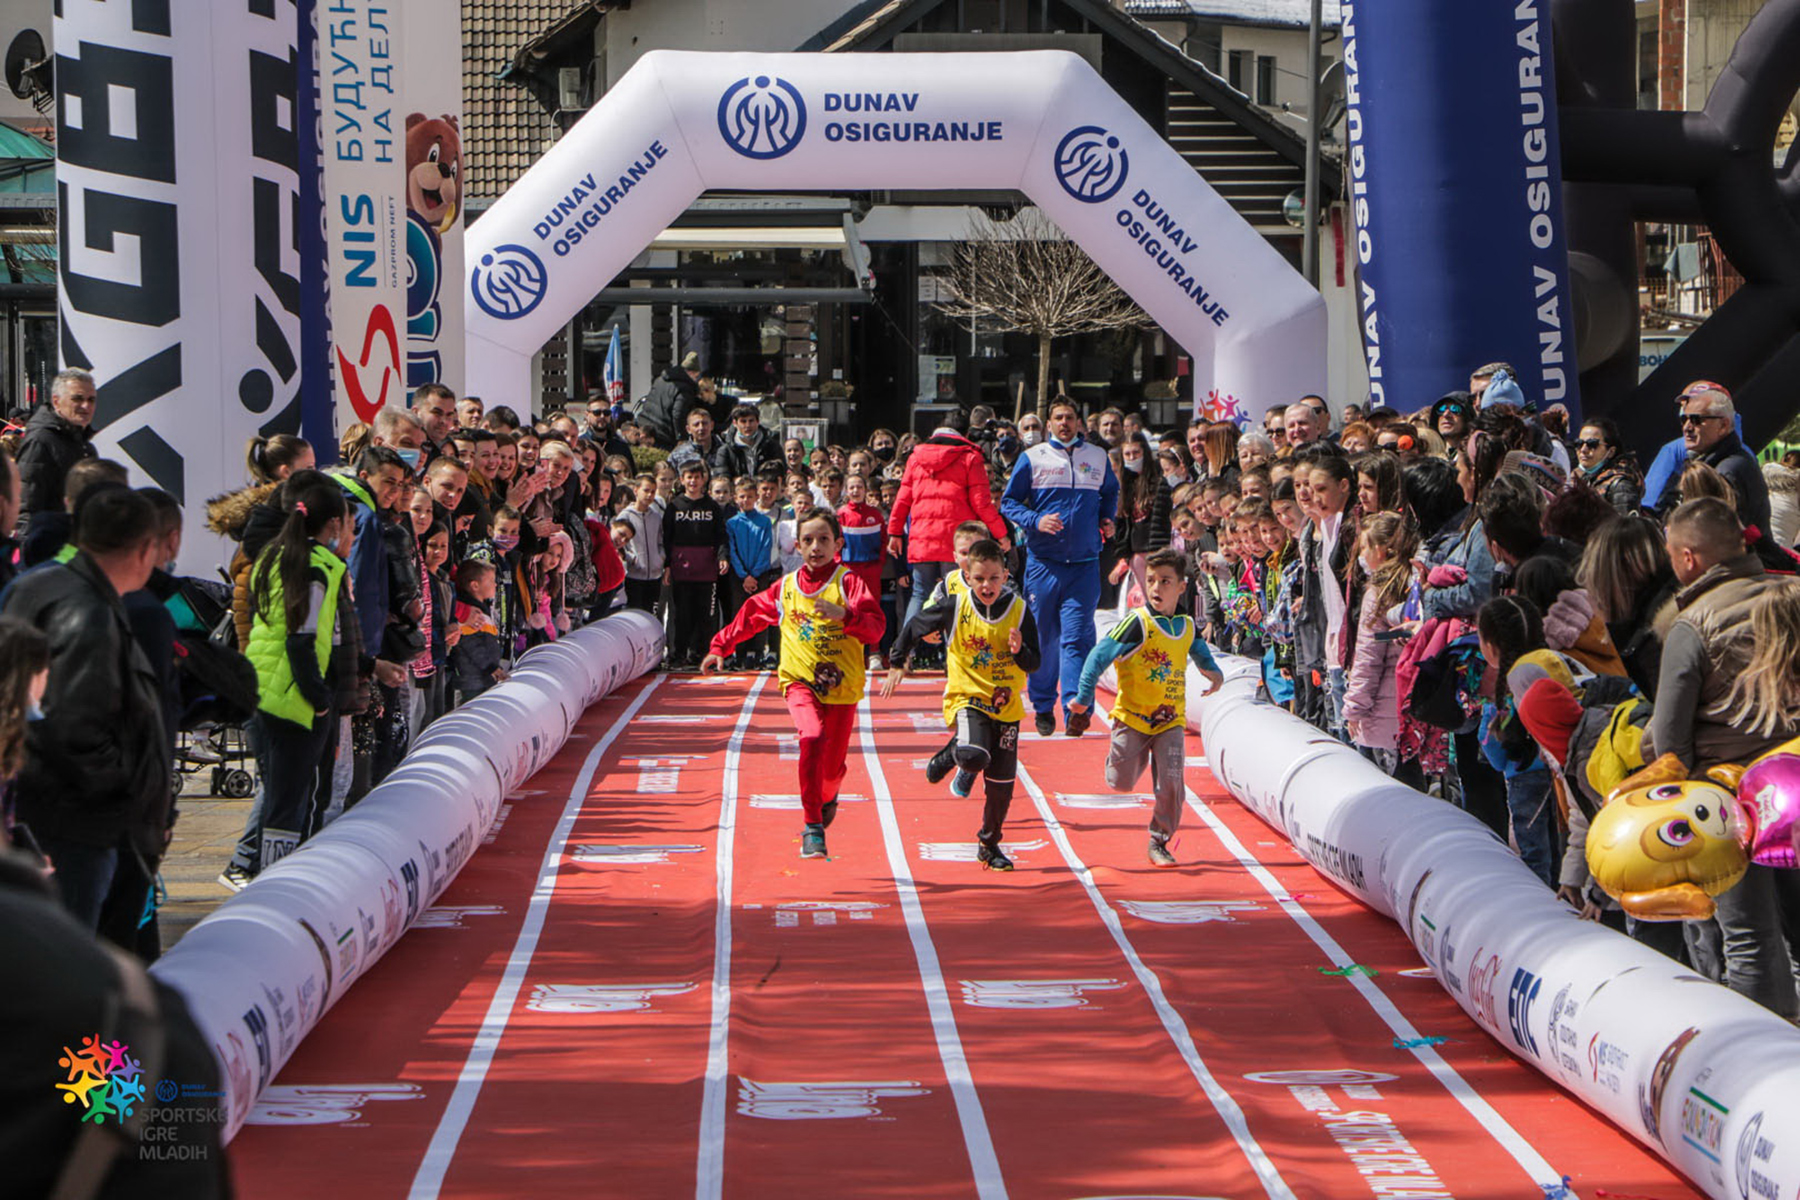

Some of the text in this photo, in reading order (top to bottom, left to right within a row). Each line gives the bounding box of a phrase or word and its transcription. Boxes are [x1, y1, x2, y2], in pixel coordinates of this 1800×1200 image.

[367, 0, 394, 162] НА ДЕЛ
[824, 93, 919, 112] DUNAV
[824, 121, 1003, 142] OSIGURANJE
[340, 194, 377, 288] NIS
[388, 195, 397, 288] GAZPROM NEFT
[533, 172, 598, 241] DUNAV
[552, 140, 669, 258] OSIGURANJE
[1132, 188, 1199, 255] DUNAV
[1341, 0, 1386, 409] UNAV OSIGURAN
[1115, 209, 1230, 328] OSIGURANJE
[675, 510, 713, 521] PARIS
